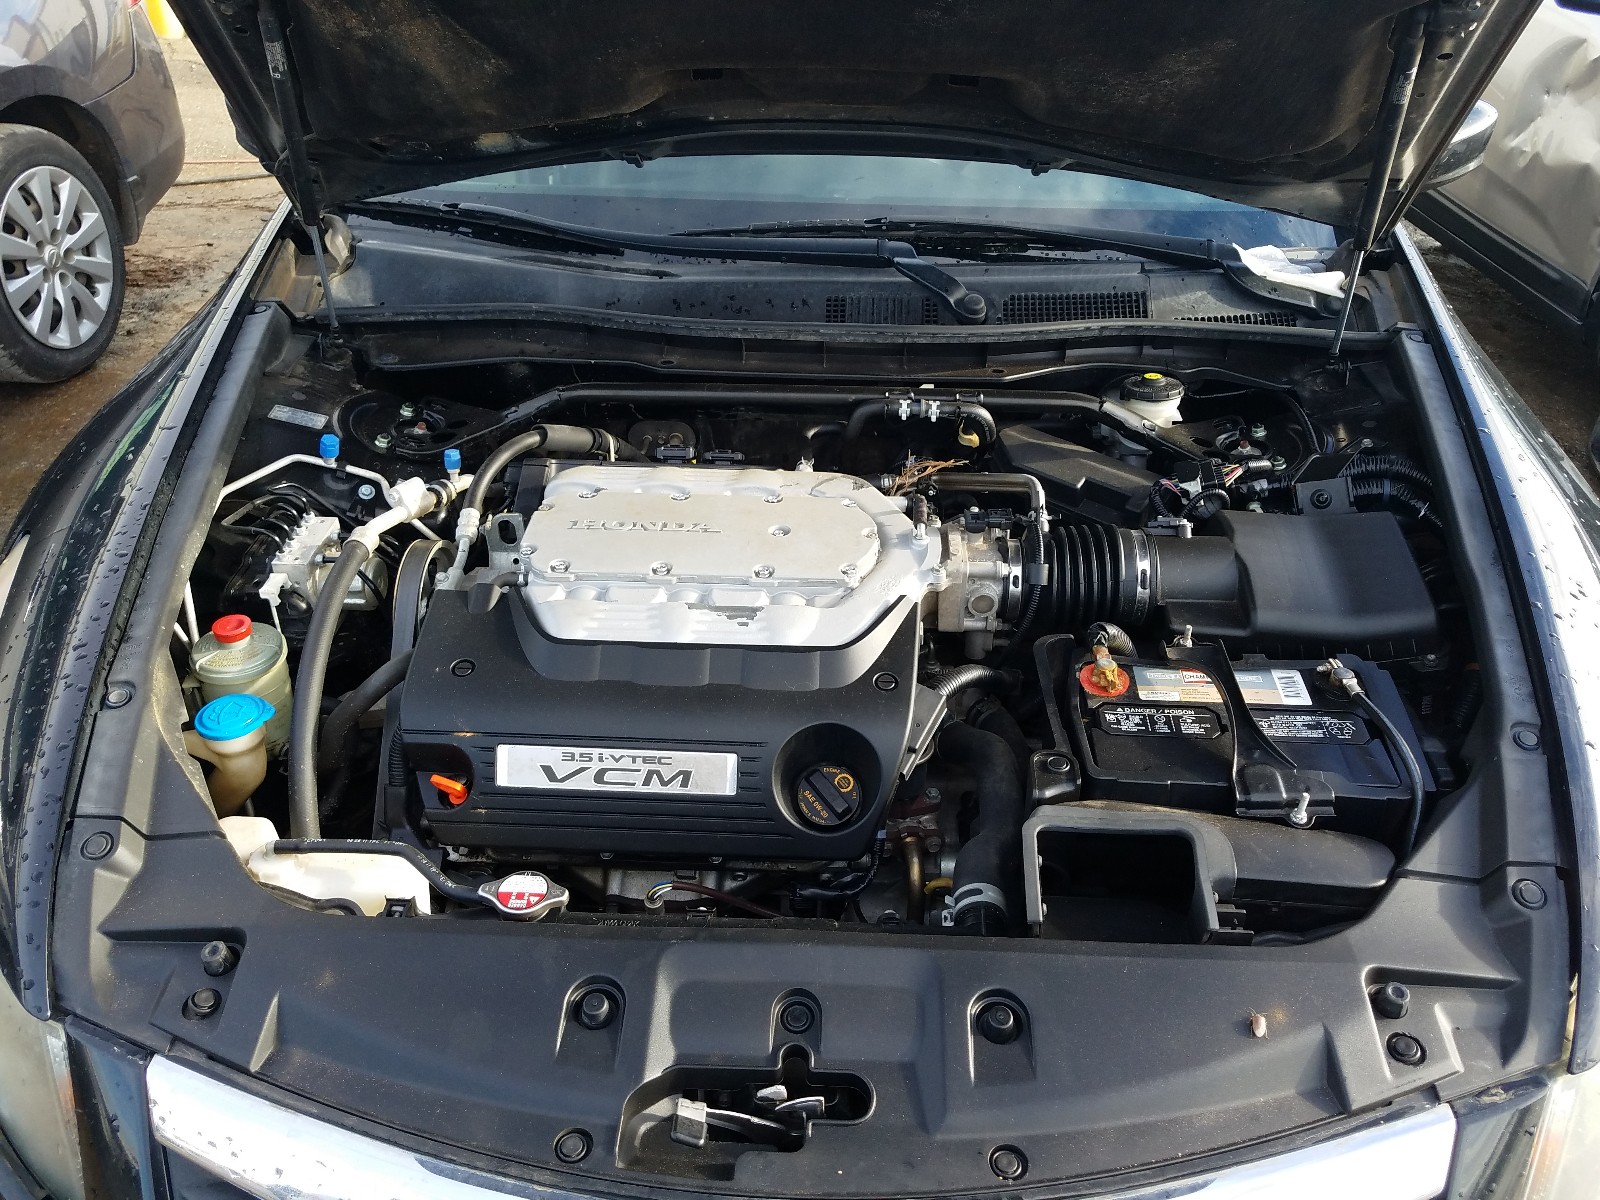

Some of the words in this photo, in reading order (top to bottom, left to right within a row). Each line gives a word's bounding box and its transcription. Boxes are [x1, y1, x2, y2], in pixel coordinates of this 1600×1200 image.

[567, 519, 722, 534] HONDA
[561, 752, 593, 763] 3.5
[598, 754, 673, 765] i-VTEC
[539, 764, 694, 789] VCM
